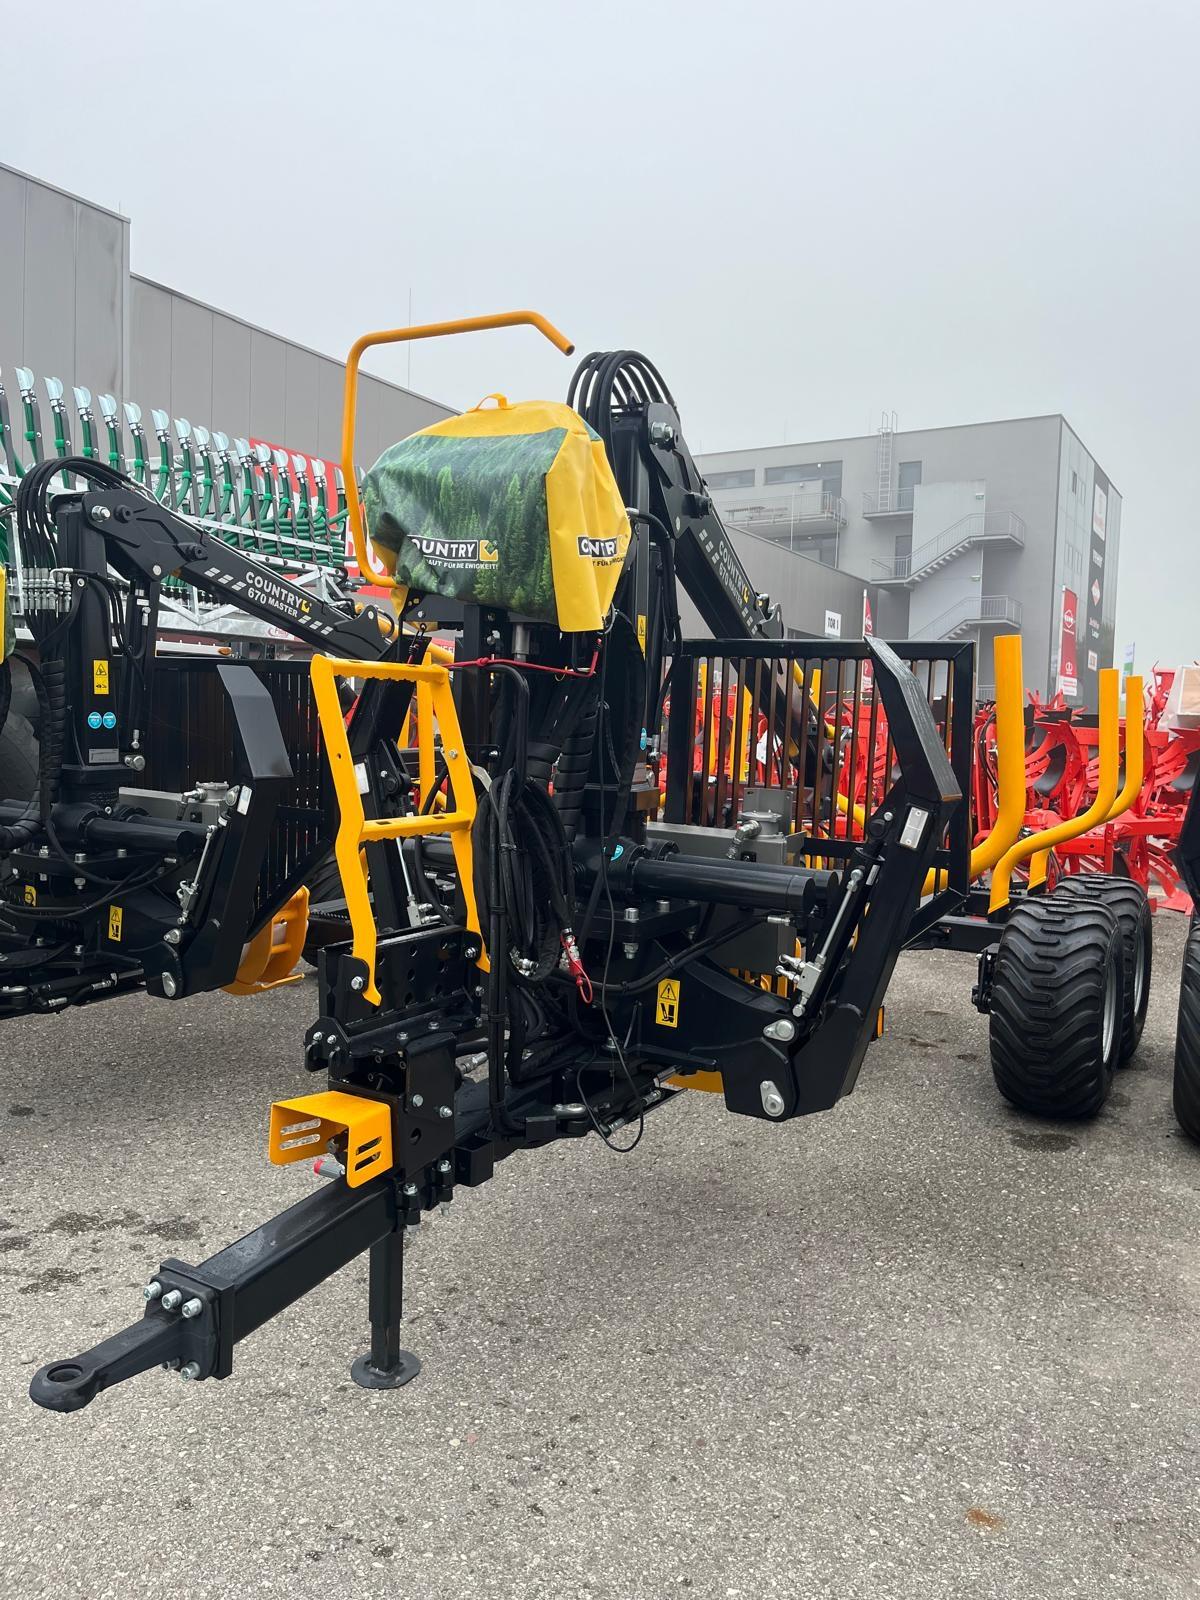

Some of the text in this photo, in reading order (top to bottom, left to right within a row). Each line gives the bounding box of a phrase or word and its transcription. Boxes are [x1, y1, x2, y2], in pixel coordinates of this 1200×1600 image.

[718, 540, 746, 595] COUNTRY
[245, 571, 303, 609] COUNTRY
[247, 587, 298, 618] 670 MASTER
